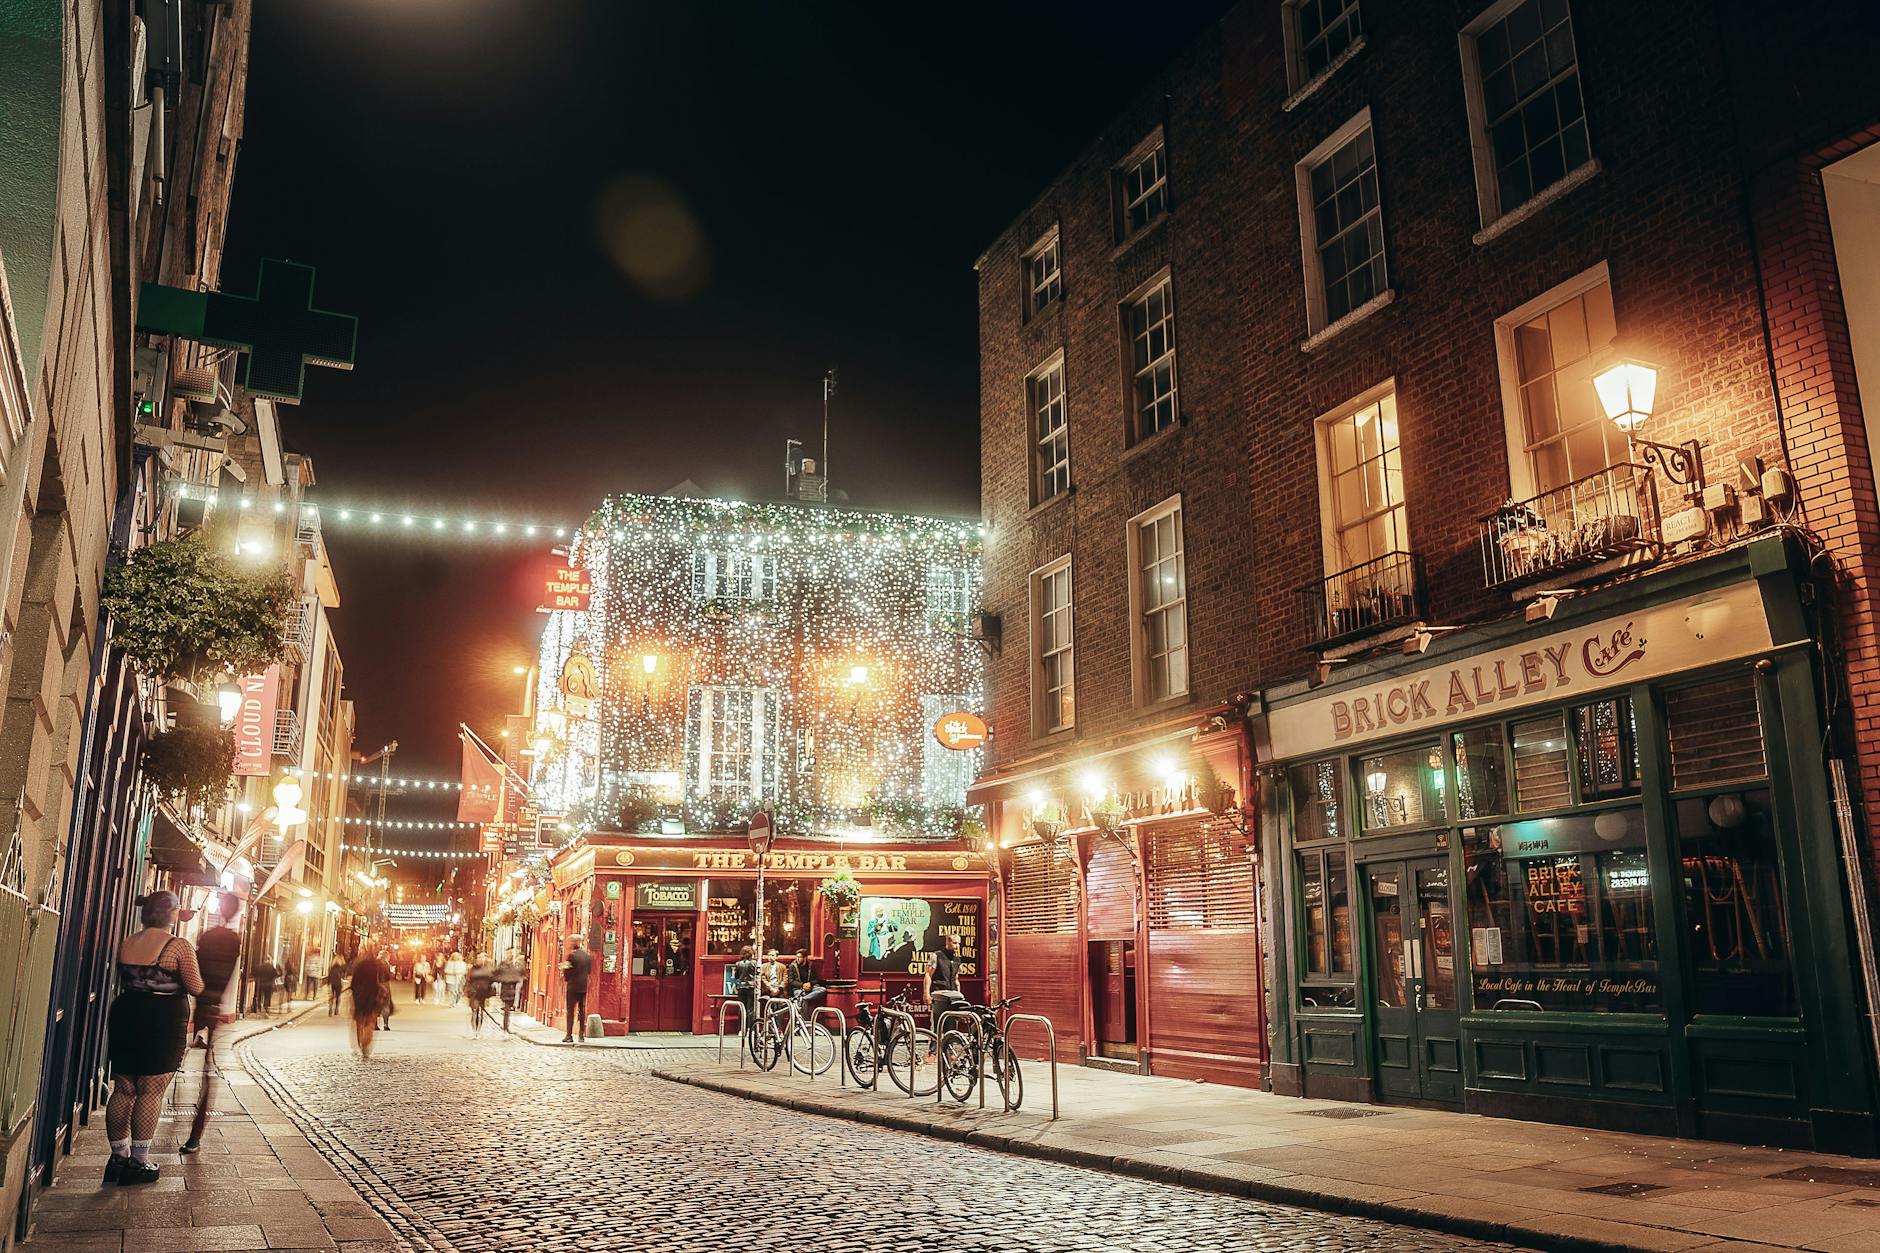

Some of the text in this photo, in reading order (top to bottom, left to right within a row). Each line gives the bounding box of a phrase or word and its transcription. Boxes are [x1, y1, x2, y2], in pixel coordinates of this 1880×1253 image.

[557, 569, 580, 582] THE
[547, 581, 590, 595] TEMPLE
[556, 595, 579, 607] BAR
[1331, 679, 1437, 741] BRICK
[1445, 642, 1573, 716] ALLEY
[240, 699, 263, 758] CLOUD
[694, 853, 746, 869] THE
[752, 853, 849, 870] TEMPLE
[859, 856, 907, 870] BAR
[1528, 864, 1578, 881] BRICK
[644, 888, 690, 904] TOBACCO
[1529, 882, 1580, 897] ALLEY
[900, 902, 917, 910] THE
[1534, 899, 1578, 913] CAFE
[892, 910, 925, 918] TEMPLE
[958, 915, 976, 926] THE
[938, 925, 976, 936] EMPEROR
[965, 936, 975, 946] OF
[1479, 978, 1502, 991] Local
[1525, 980, 1533, 991] in
[1537, 979, 1550, 992] the
[1553, 978, 1581, 992] Heart
[1585, 979, 1597, 996] of
[900, 1004, 932, 1012] TEMPL
